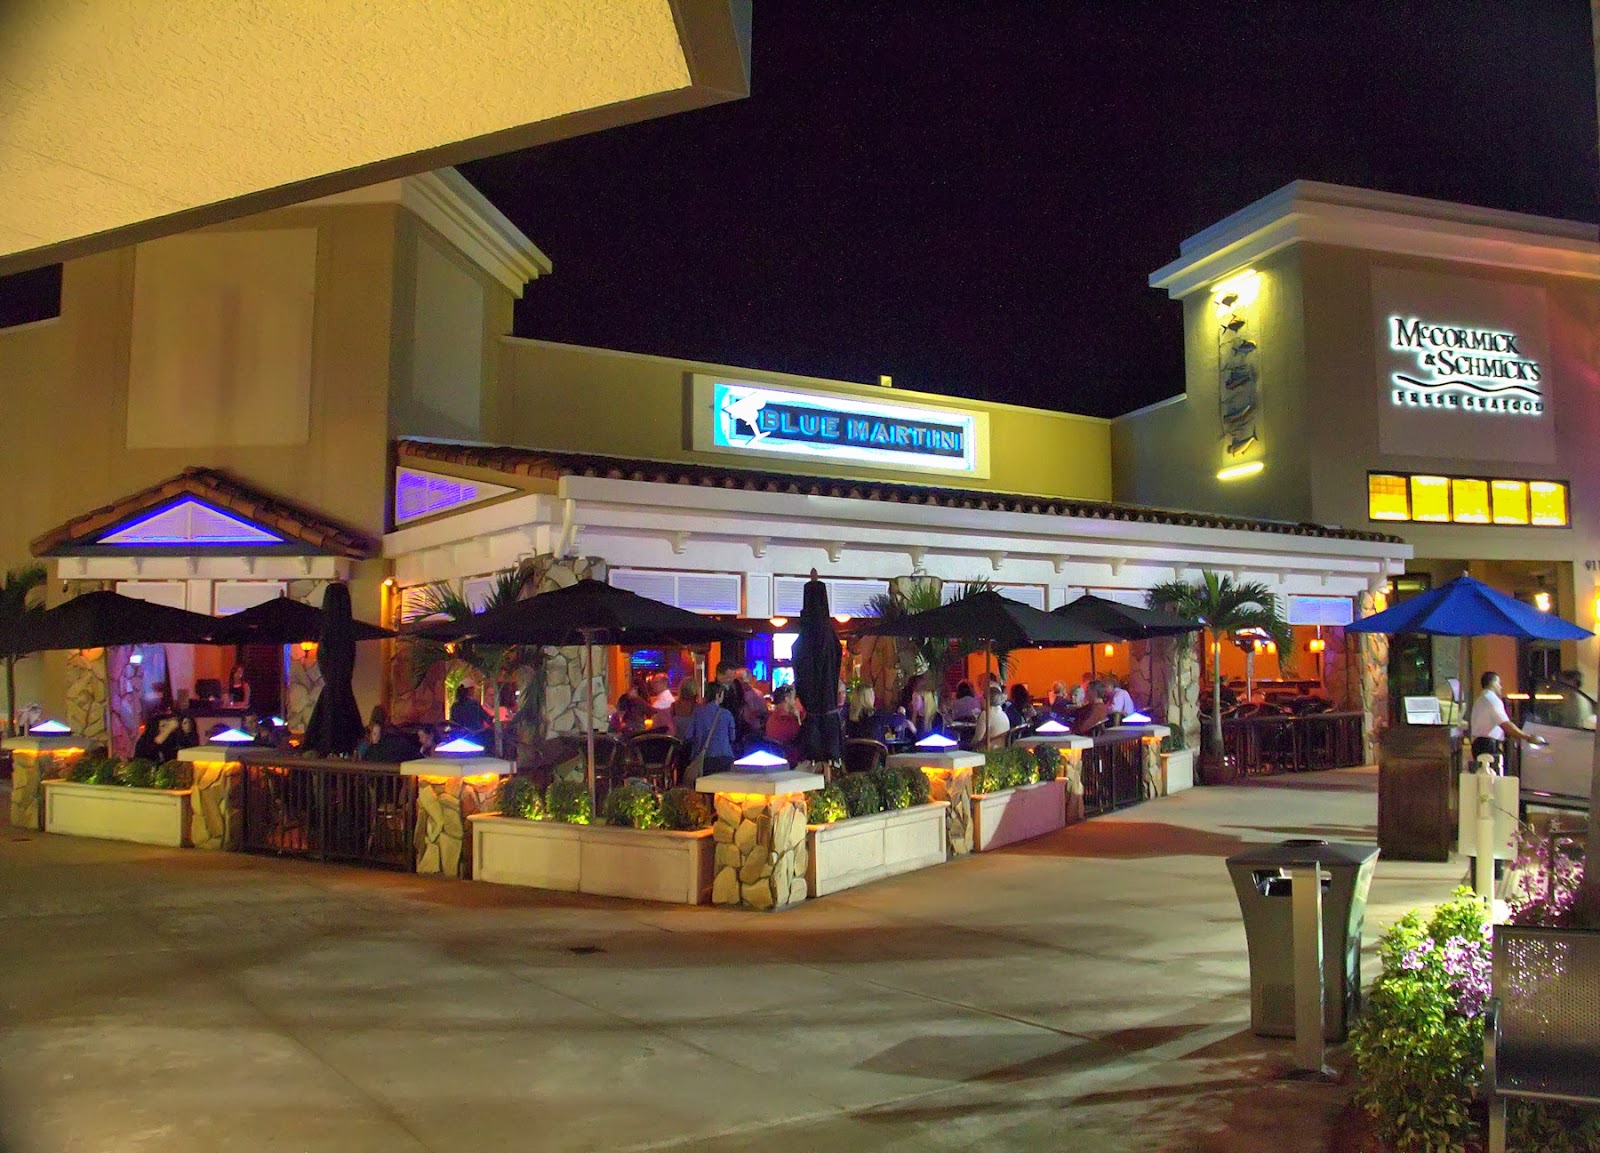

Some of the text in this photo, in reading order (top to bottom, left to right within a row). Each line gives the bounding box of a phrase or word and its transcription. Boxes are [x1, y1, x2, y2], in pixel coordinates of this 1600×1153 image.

[1424, 353, 1436, 366] &
[1397, 391, 1544, 412] FRESH SEAFOOD
[759, 408, 965, 451] BLUE MARTINI
